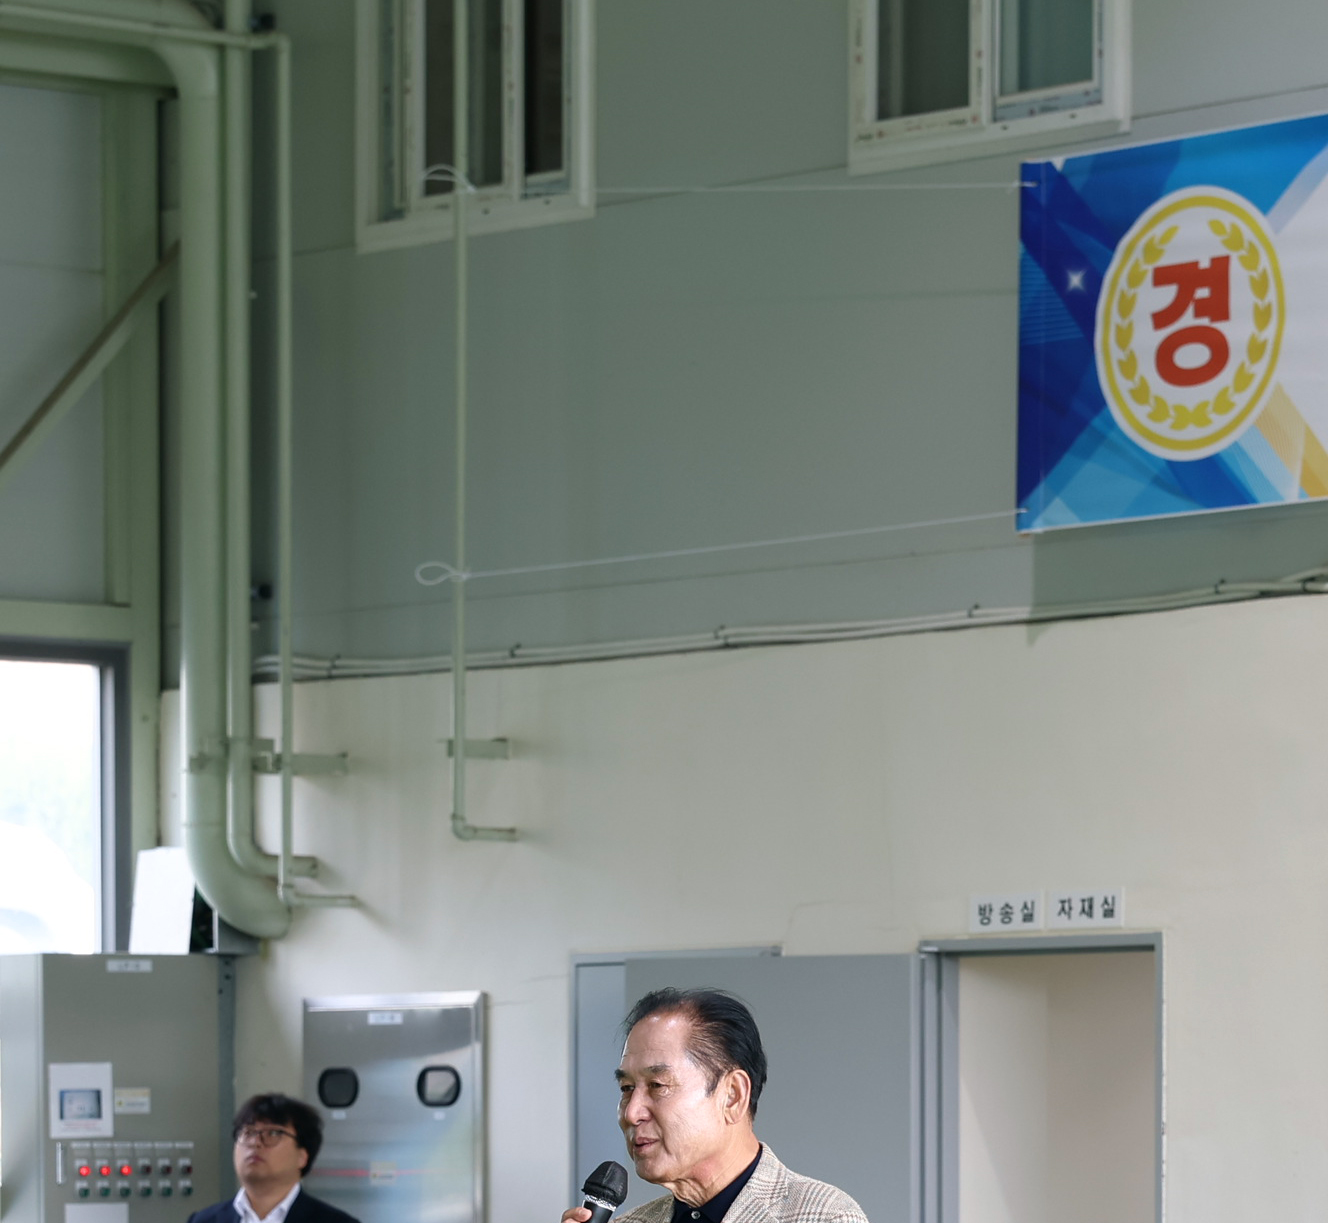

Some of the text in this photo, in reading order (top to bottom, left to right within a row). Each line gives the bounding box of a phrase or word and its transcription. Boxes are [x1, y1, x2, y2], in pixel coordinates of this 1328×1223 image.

[1151, 255, 1230, 387] 경
[978, 895, 1116, 926] 방송실 자재실
